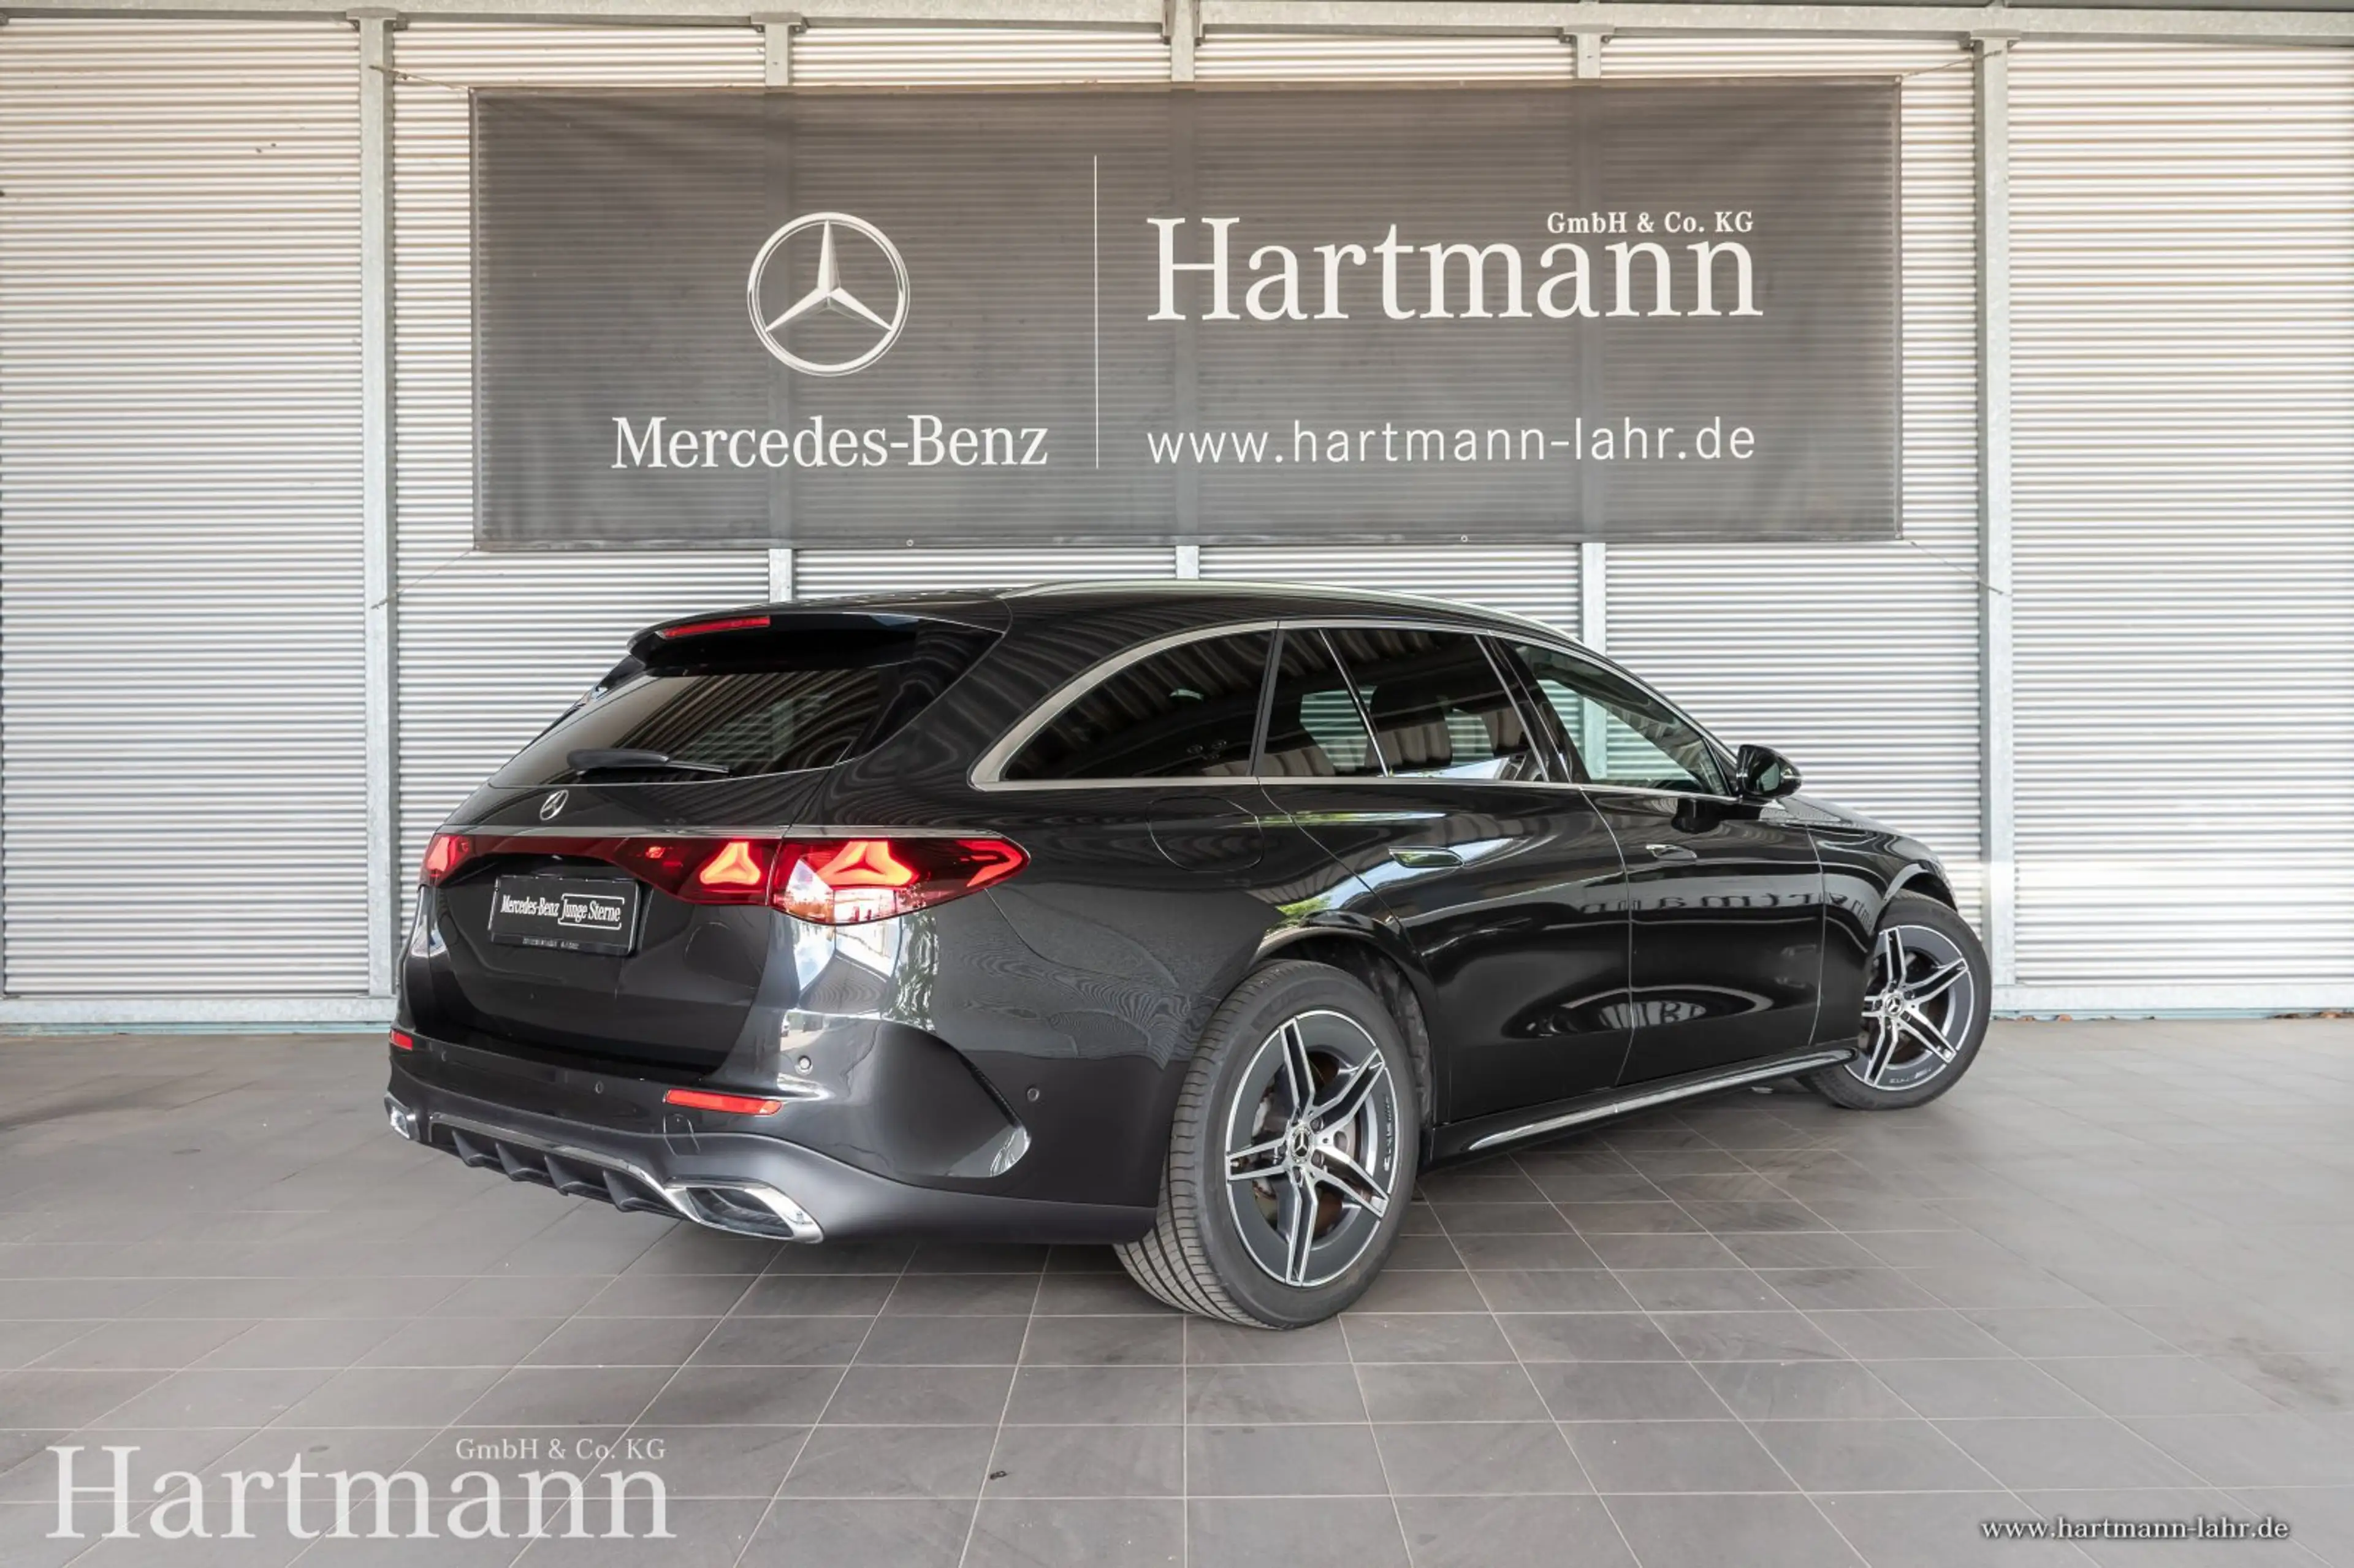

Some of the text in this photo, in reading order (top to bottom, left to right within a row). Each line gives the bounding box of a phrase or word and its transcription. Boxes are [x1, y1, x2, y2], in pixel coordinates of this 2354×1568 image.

[1547, 211, 1753, 233] GmbH & Co. KG
[1147, 217, 1763, 321] Hartmann
[611, 415, 1048, 468] Mercedes-Benz
[1147, 417, 1755, 463] www.hartmann-lahr.de
[500, 894, 622, 923] Mercedes-Benz Junge Sterne
